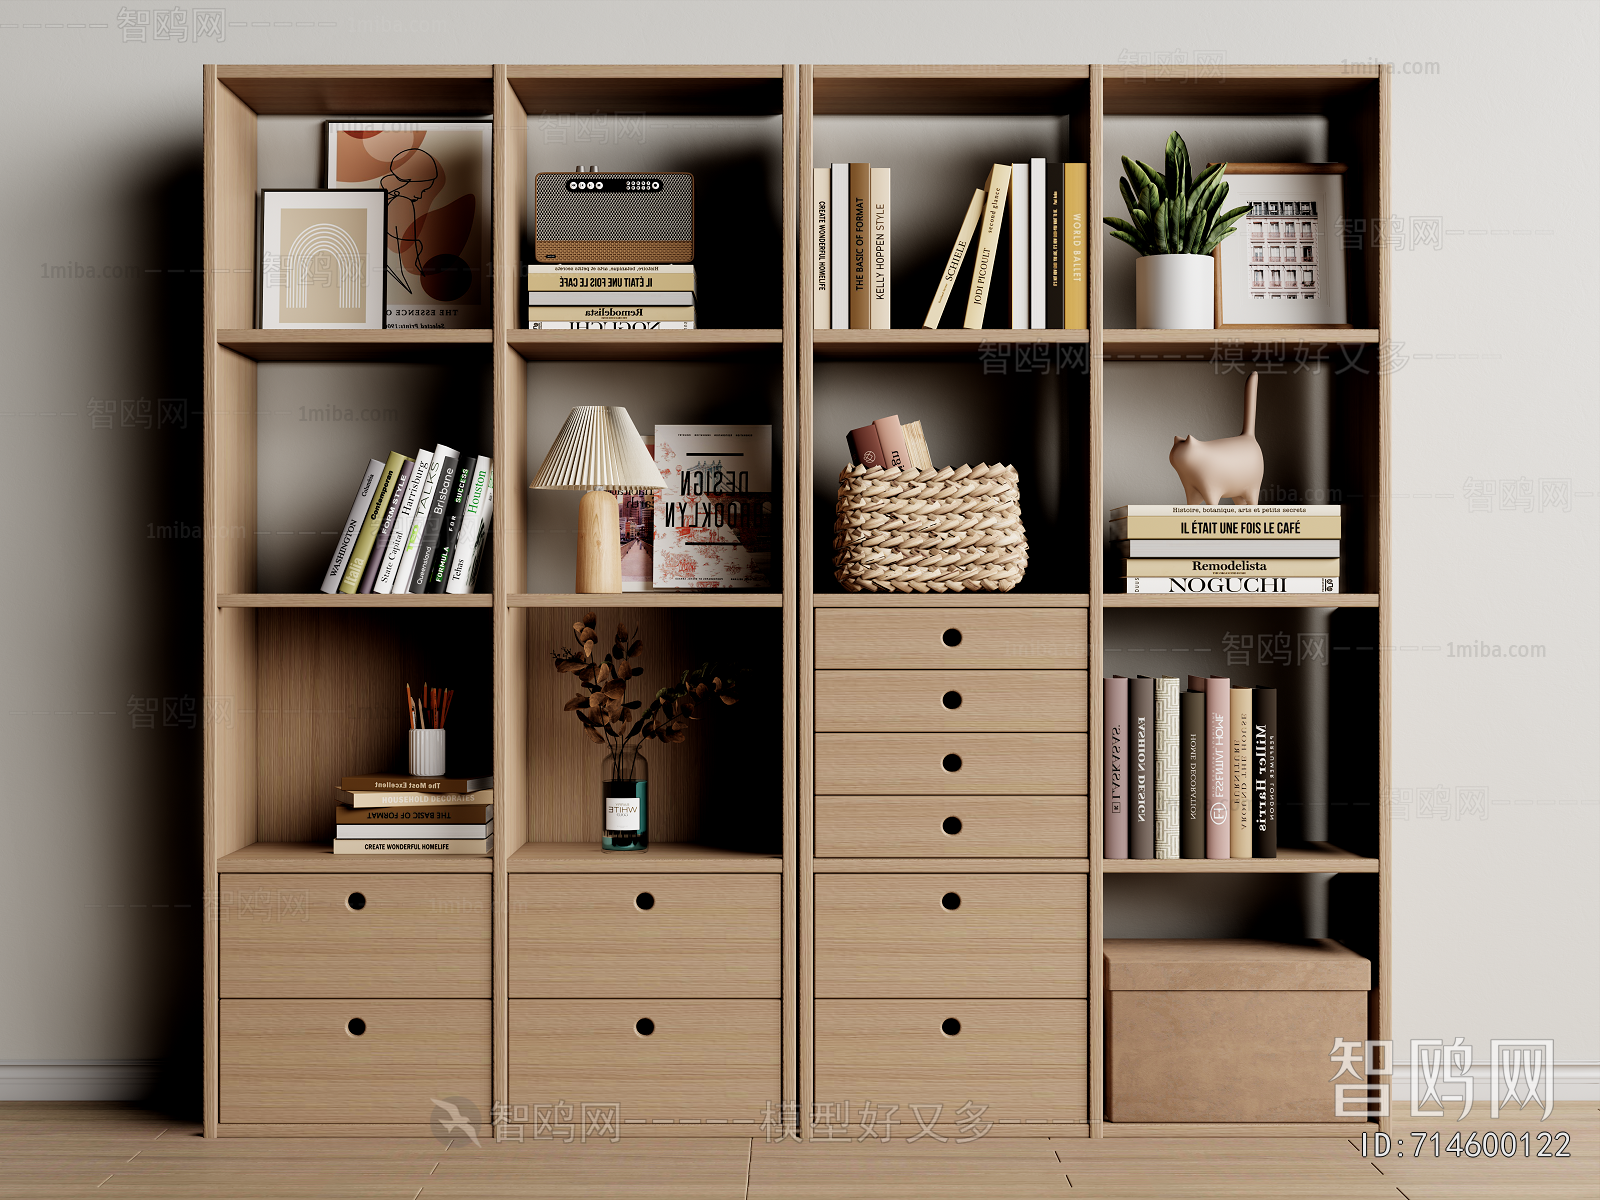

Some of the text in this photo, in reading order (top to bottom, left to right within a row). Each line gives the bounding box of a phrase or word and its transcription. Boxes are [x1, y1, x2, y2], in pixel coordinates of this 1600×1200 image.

[988, 187, 1001, 233] second glance
[818, 201, 826, 291] CREATE WONDERFUL HOMELIFE
[855, 197, 864, 291] THE BASIC OF FORMAT
[875, 203, 885, 300] KELLY HOPPEN STYLE
[945, 240, 967, 282] SCHIELE
[1073, 213, 1081, 281] WORLD BALLET
[973, 247, 991, 306] JODI PICOULT
[381, 474, 407, 535] FORM STYLE
[416, 461, 440, 517] TALKS
[433, 467, 454, 515] Brisbane
[467, 470, 487, 514] Houston
[1202, 507, 1237, 515] botanique,
[380, 460, 429, 584] State Capital Harrisburg
[435, 546, 450, 583] FORMULA
[454, 468, 469, 503] SUCCESS
[1181, 519, 1301, 534] IL ÉTAIT UNE FOIS LE CAFÉ
[329, 519, 357, 577] WASHINGTON
[344, 557, 364, 587] Italia
[1192, 560, 1267, 571] Remodelista
[1168, 577, 1287, 593] NOGUCHI
[382, 794, 475, 804] HOUSEHOLD DECORATES
[364, 843, 449, 851] CREATE WONDERFUL HOMELIFE
